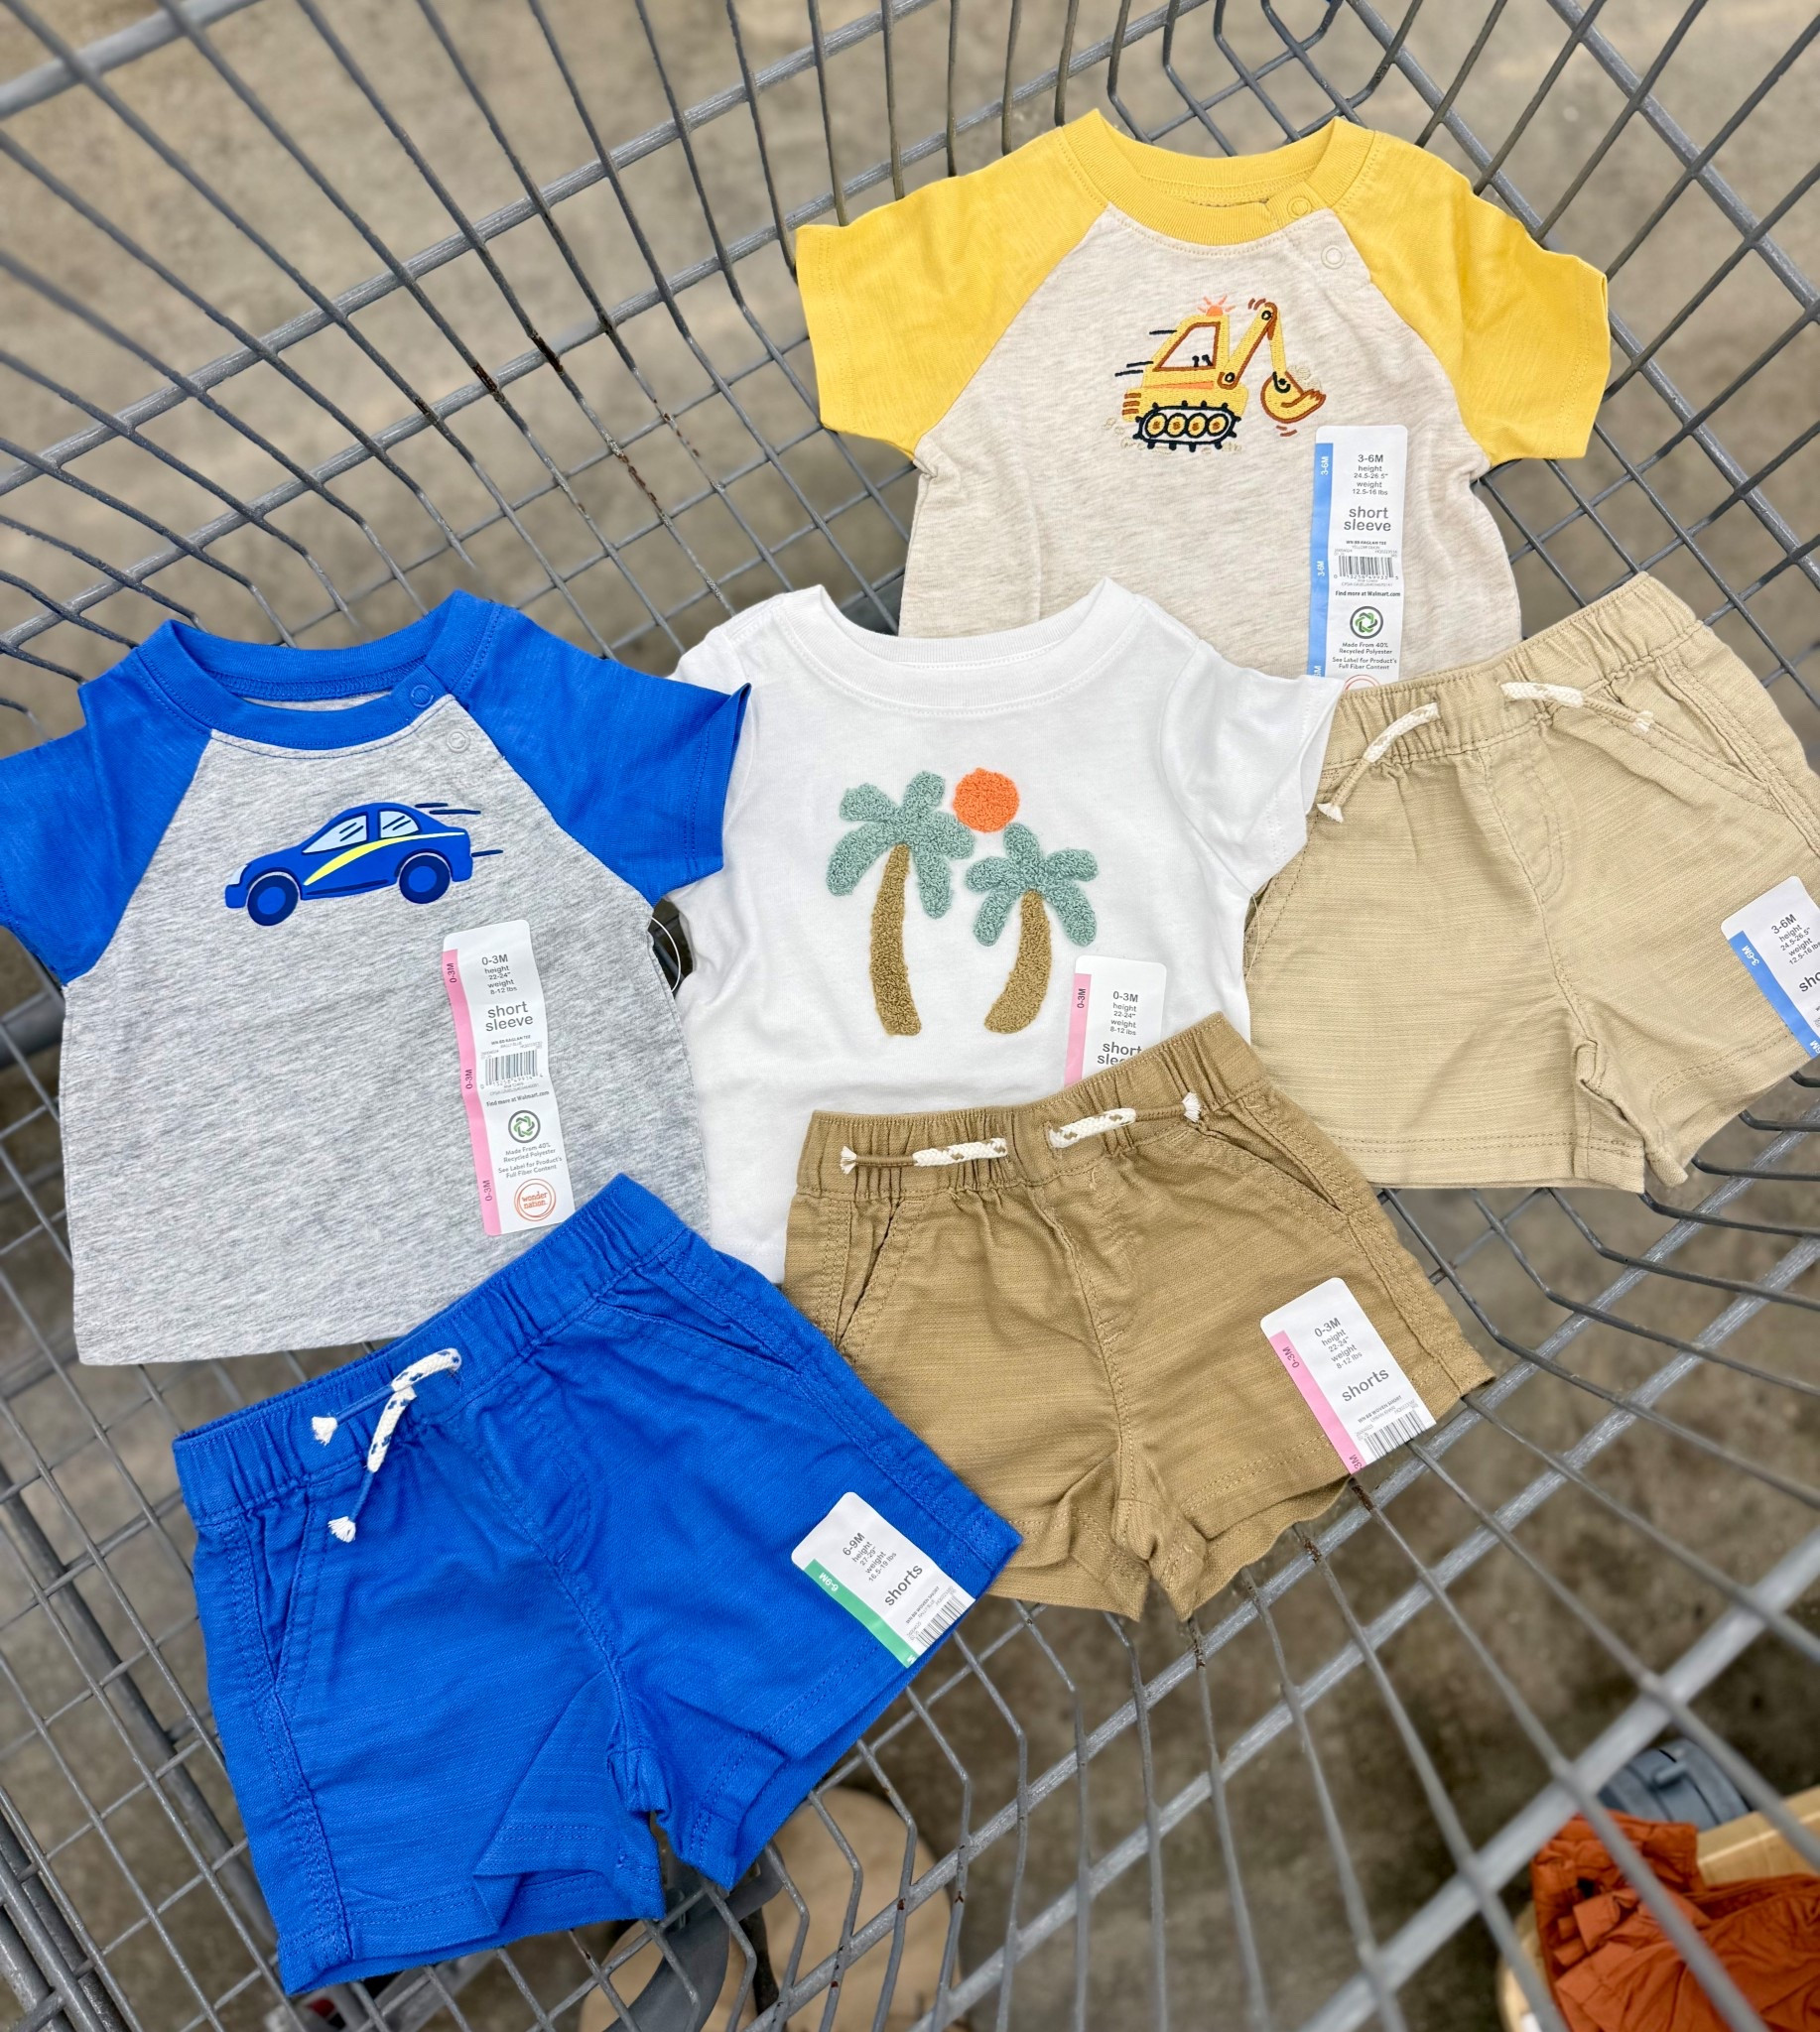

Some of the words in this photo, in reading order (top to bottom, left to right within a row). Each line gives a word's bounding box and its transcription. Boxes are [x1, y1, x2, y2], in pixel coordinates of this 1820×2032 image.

[1349, 506, 1388, 519] short
[1344, 519, 1391, 531] sleeve
[1771, 914, 1797, 935] 3-6M
[1778, 924, 1802, 943] height
[1742, 946, 1759, 966] 3-6M
[1788, 938, 1813, 956] weight
[1789, 947, 1813, 965] 12.5-16
[481, 953, 508, 965] 0-3M
[447, 963, 456, 983] 0-3M
[484, 965, 509, 974] height
[487, 979, 514, 988] weight
[1798, 971, 1820, 992] sho
[1077, 988, 1086, 1008] 0-3M
[1113, 991, 1138, 1002] 0-3M
[488, 1001, 528, 1018] short
[1113, 1002, 1137, 1012] height
[486, 1015, 533, 1031] sleeve
[1110, 1019, 1136, 1028] weight
[518, 1091, 549, 1100] Walmart.com
[531, 1149, 556, 1158] Polyester
[536, 1157, 563, 1166] Product's
[483, 1180, 492, 1202] 0-3M
[522, 1192, 548, 1202] wonder
[1314, 1317, 1341, 1337] 0-3M
[1322, 1329, 1347, 1346] height
[1282, 1346, 1300, 1368] 0-3M
[1331, 1344, 1358, 1362] weight
[1337, 1356, 1352, 1369] 8-12
[1351, 1351, 1363, 1360] lbs
[1342, 1368, 1389, 1402] shorts
[1370, 1403, 1388, 1415] WOVEN
[843, 1532, 865, 1556] 6-9M
[852, 1541, 872, 1563] height
[865, 1552, 886, 1574] weight
[869, 1559, 891, 1583] 16.5-19
[887, 1552, 897, 1563] lbs
[819, 1572, 839, 1592] 6-9M
[884, 1565, 923, 1606] shorts
